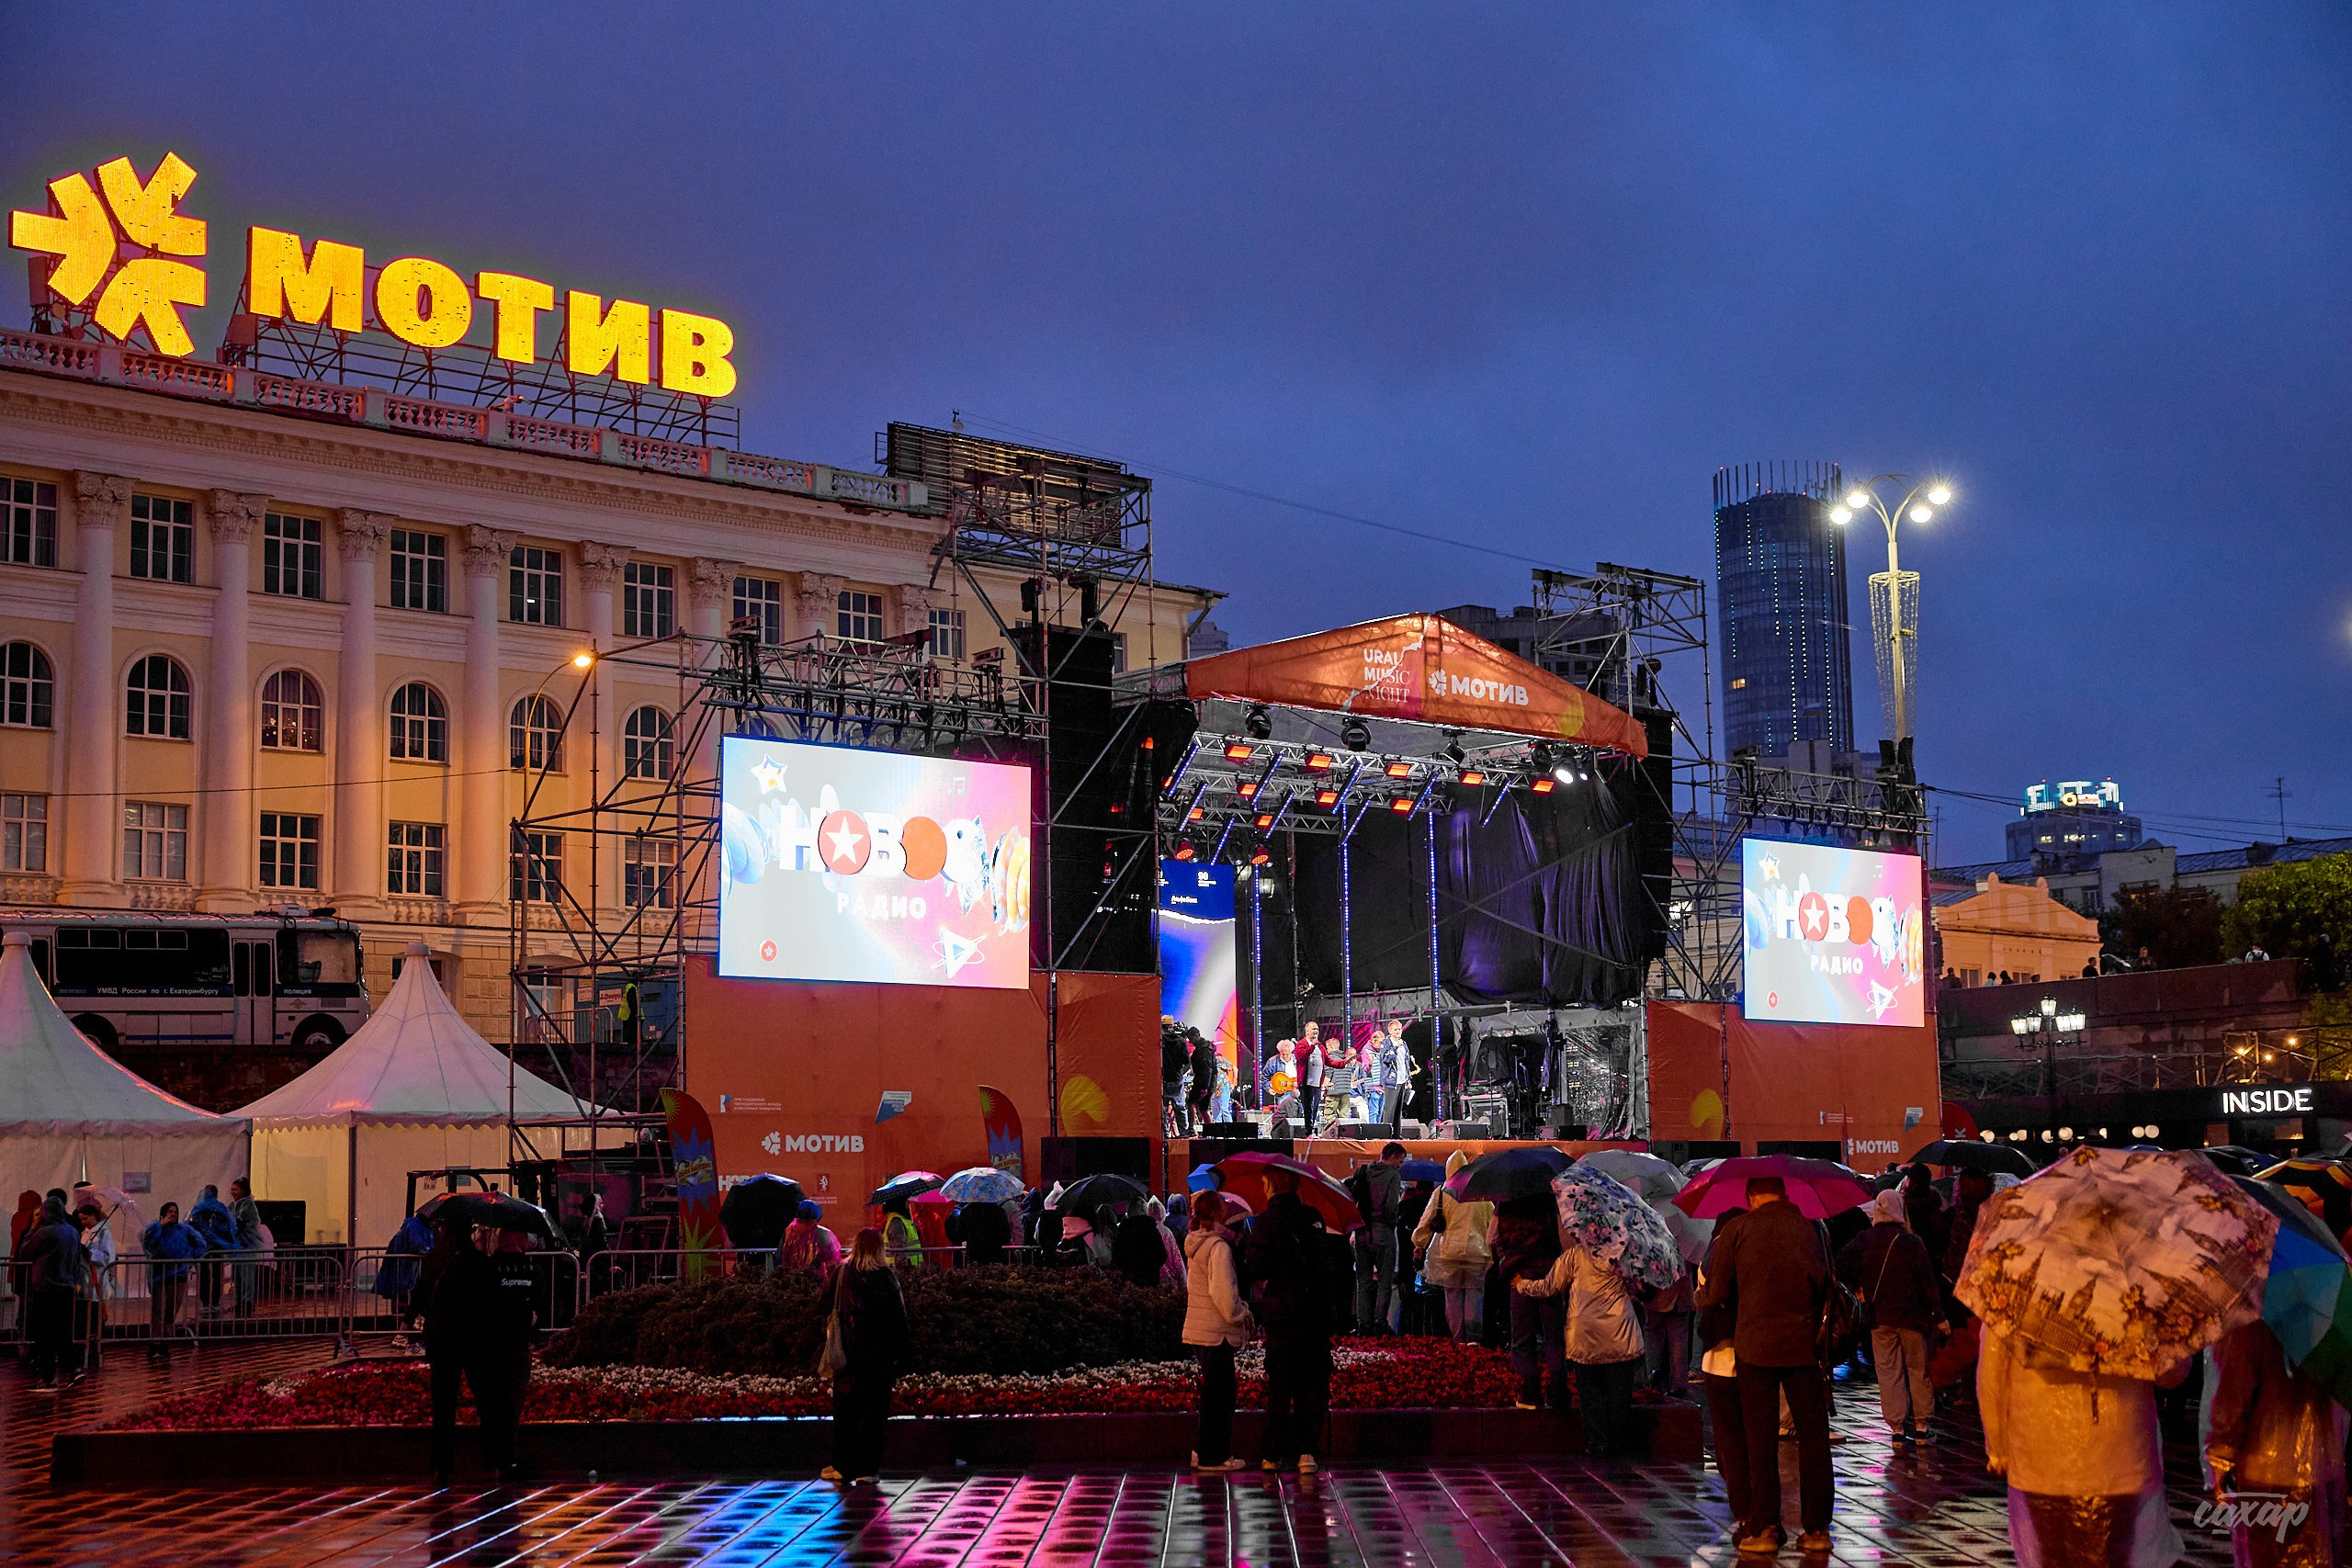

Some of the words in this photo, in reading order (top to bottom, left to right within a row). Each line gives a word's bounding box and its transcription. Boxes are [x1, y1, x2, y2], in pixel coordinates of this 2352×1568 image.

[246, 225, 738, 399] МОТИВ
[1363, 649, 1403, 667] URAL
[1363, 666, 1411, 685] MUSIC
[1365, 685, 1410, 704] NIGHT
[1451, 674, 1530, 706] МОТИВ
[837, 891, 927, 919] РАДИО
[1810, 953, 1864, 976] РАДИО
[96, 987, 118, 995] УМВД
[2222, 1089, 2313, 1114] INSIDE
[786, 1134, 865, 1154] МОТИВ
[1856, 1140, 1900, 1154] МОТИВ
